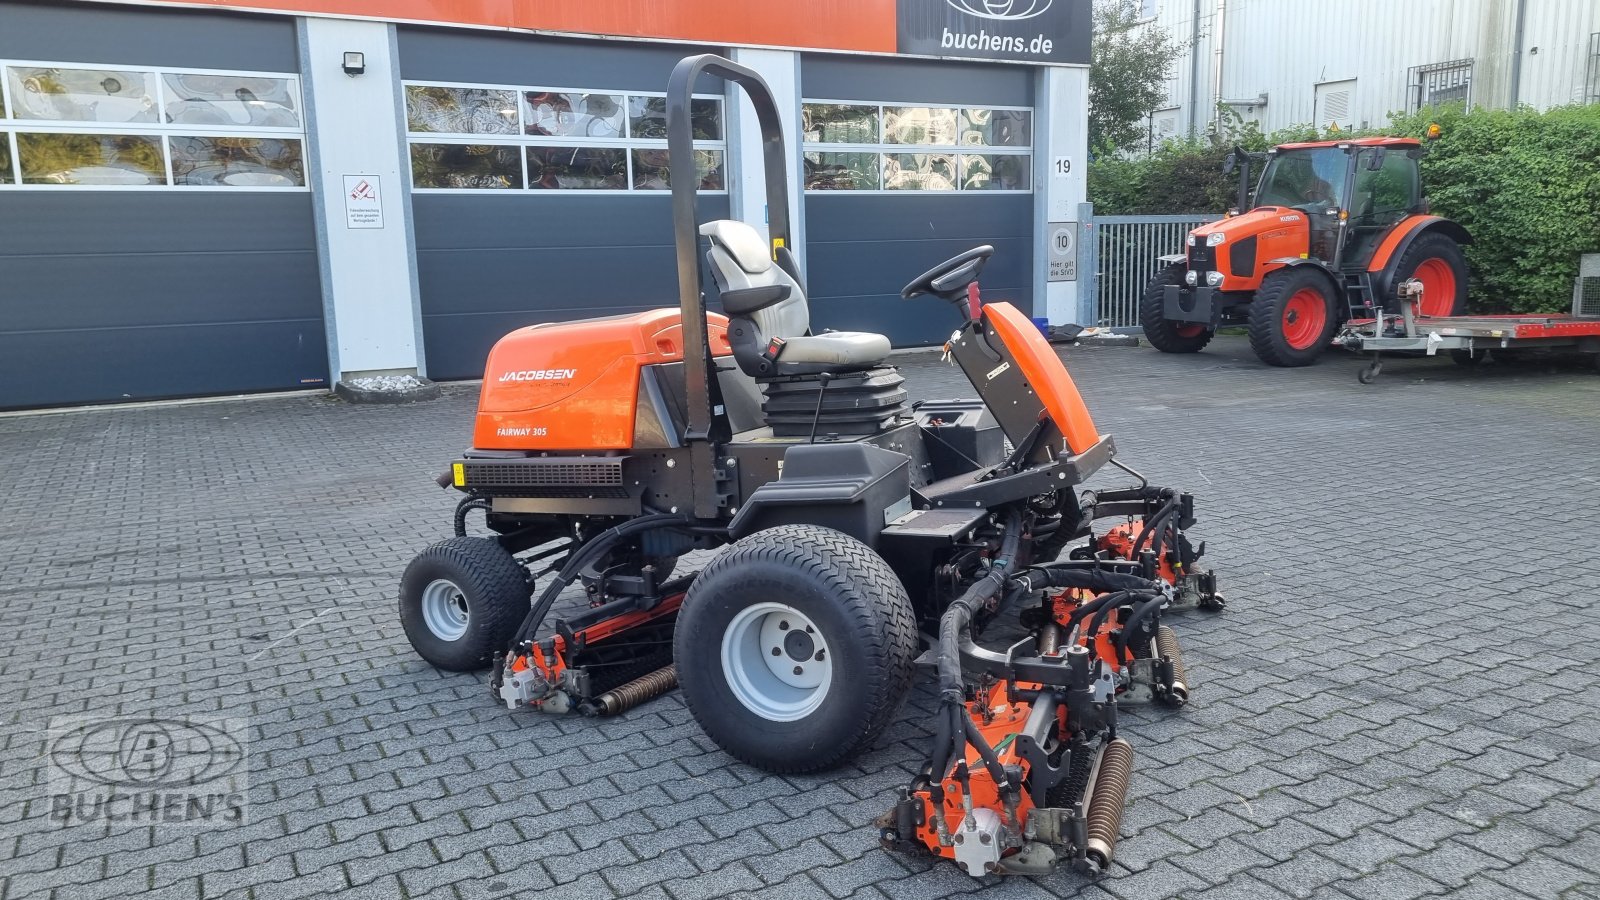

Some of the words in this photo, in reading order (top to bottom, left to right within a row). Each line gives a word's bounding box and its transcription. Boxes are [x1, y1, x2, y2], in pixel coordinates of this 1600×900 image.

[941, 28, 1053, 54] buchens.de
[1056, 159, 1071, 173] 19
[1057, 235, 1068, 248] 10
[1050, 260, 1062, 268] Hier
[1064, 260, 1074, 269] gilt
[499, 369, 575, 381] JACOBSEN
[497, 428, 530, 436] FAIRWAY
[533, 427, 547, 436] 305
